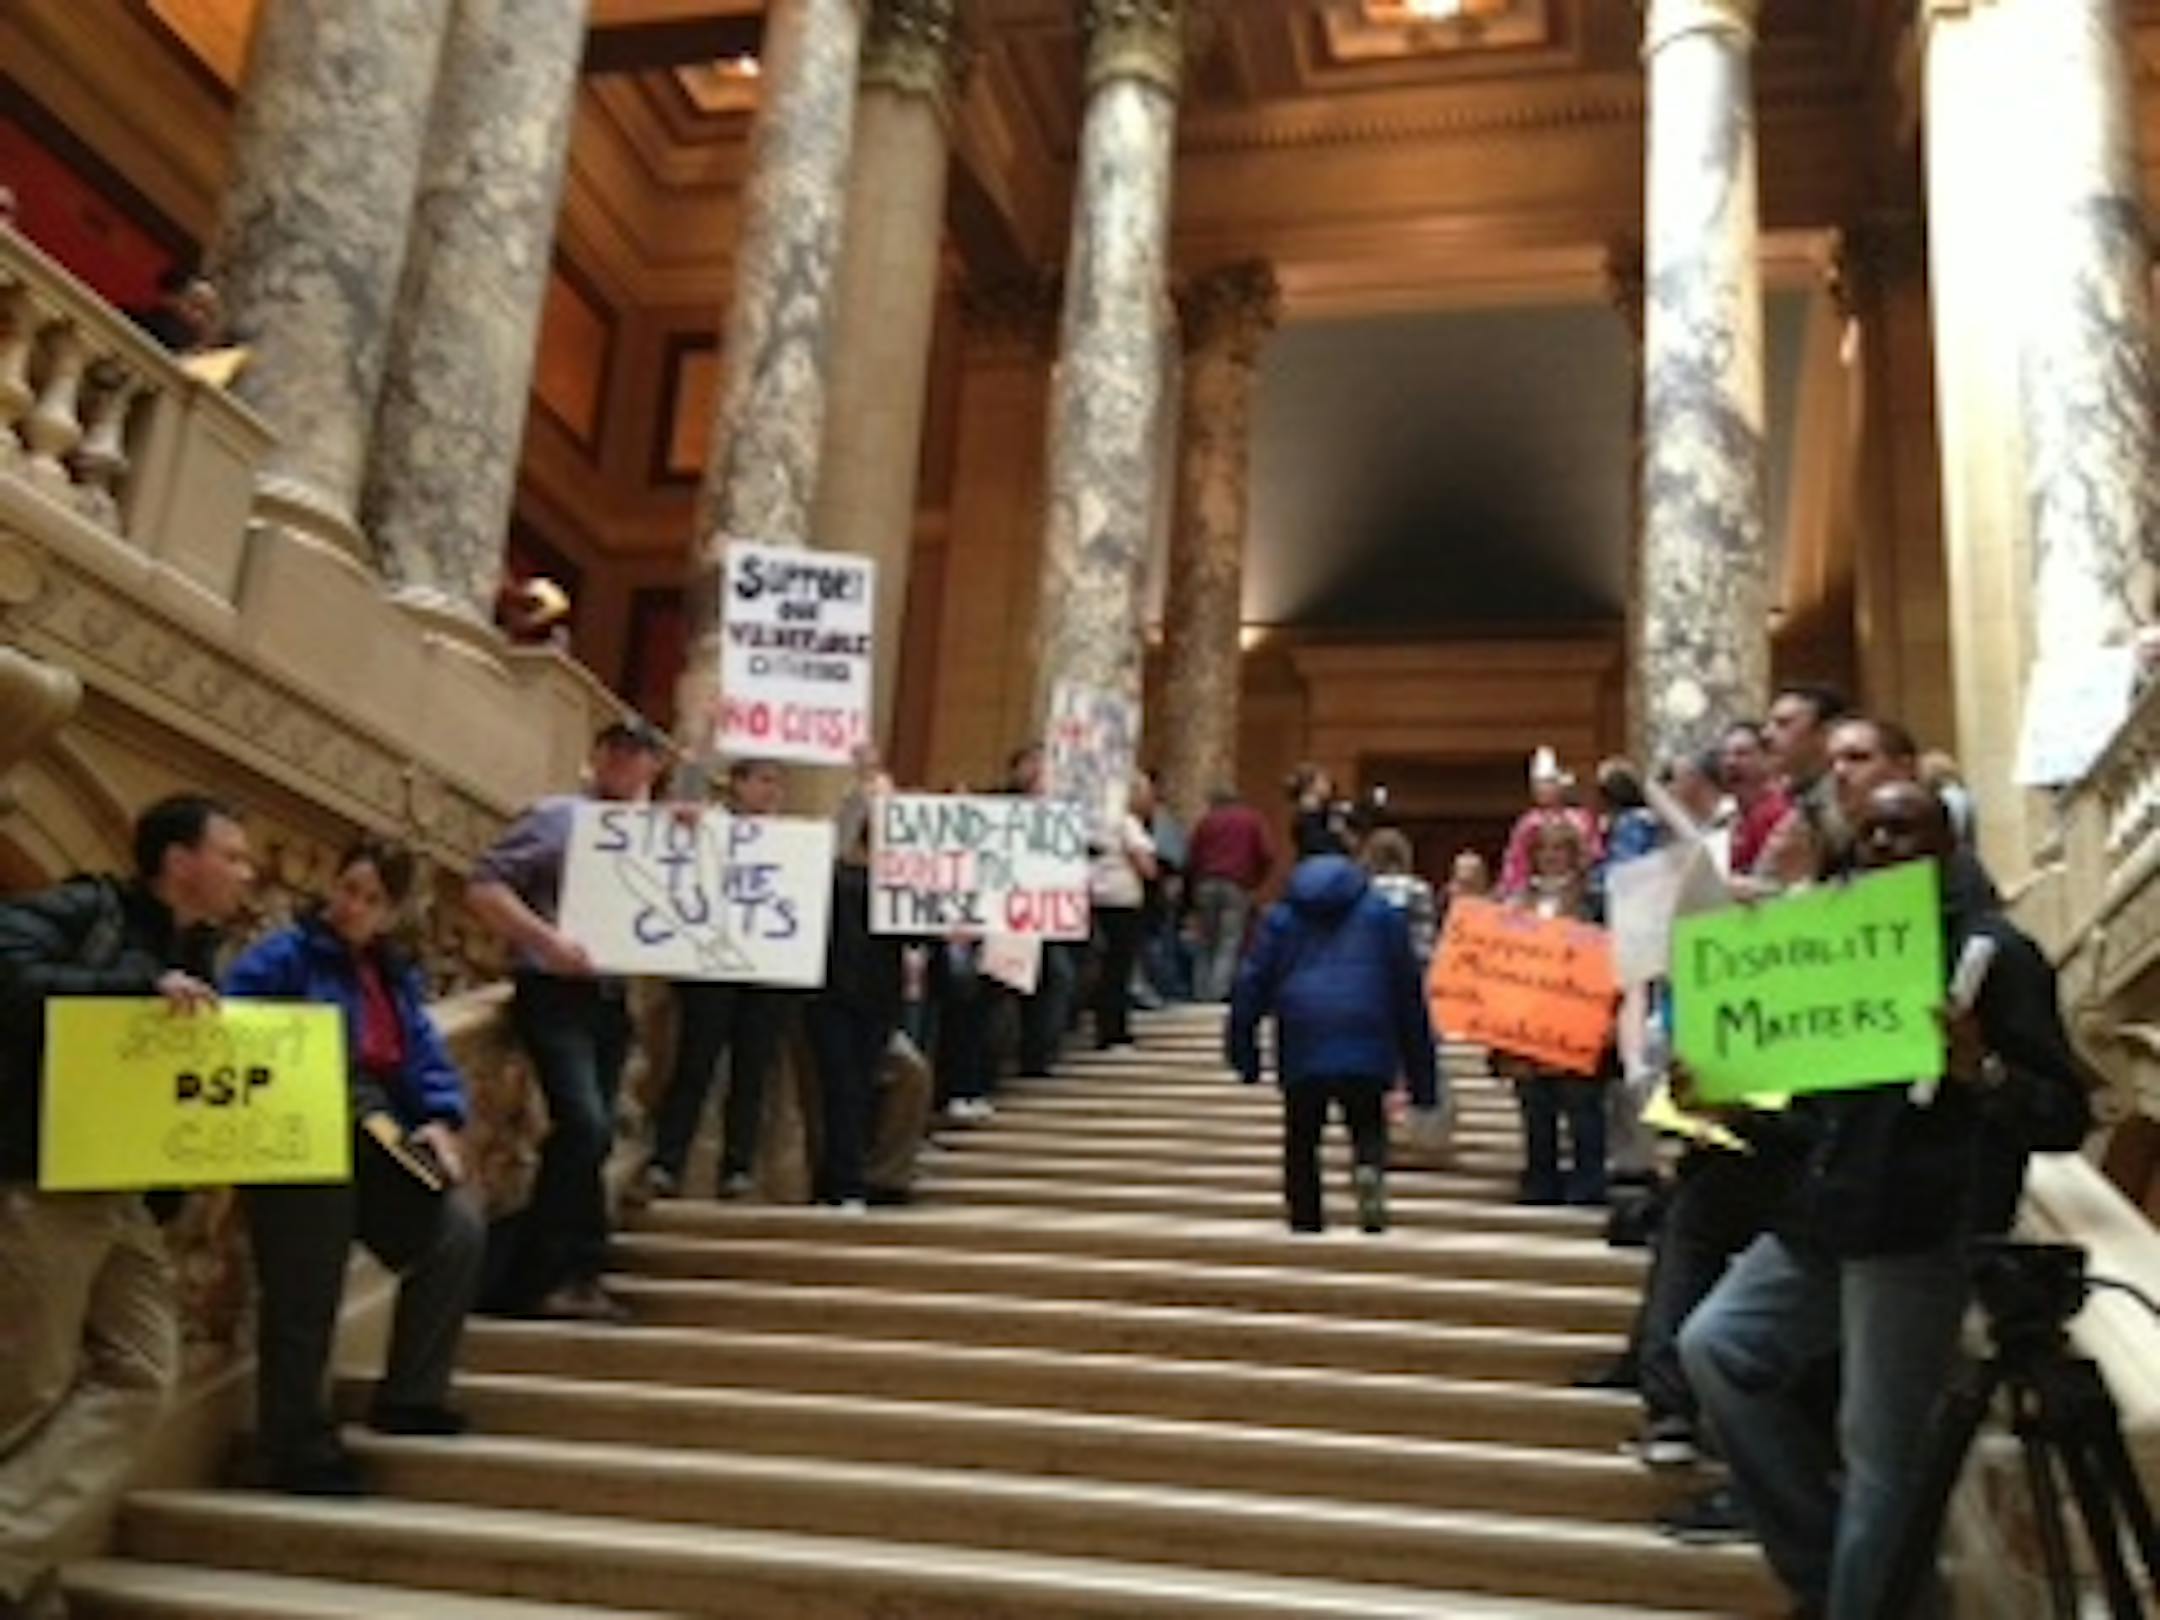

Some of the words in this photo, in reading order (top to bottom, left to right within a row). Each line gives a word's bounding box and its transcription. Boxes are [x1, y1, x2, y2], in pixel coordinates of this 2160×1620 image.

[718, 703, 771, 737] NO
[594, 809, 763, 857] STOP
[174, 1065, 271, 1107] DSP
